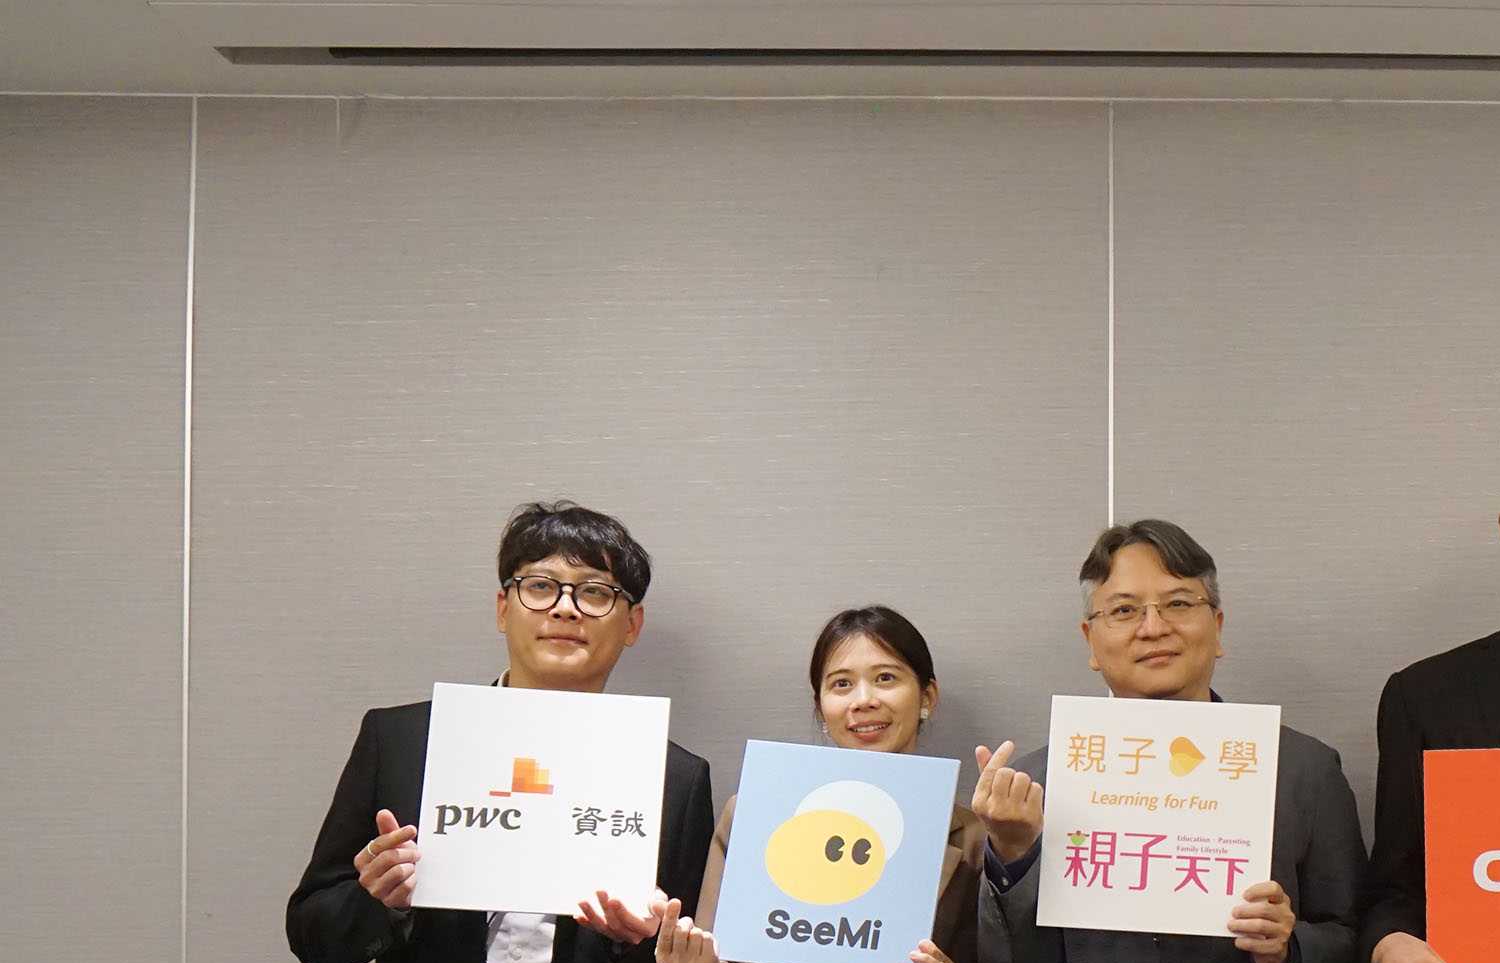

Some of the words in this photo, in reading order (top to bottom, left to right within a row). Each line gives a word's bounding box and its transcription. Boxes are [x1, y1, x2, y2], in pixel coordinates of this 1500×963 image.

[1066, 733, 1157, 776] 親子
[433, 803, 522, 835] pwc
[1090, 790, 1158, 811] Learning
[1163, 793, 1187, 809] for
[1188, 795, 1218, 811] Fun
[572, 806, 647, 838] 資誠
[1064, 830, 1249, 897] 親子天下
[765, 908, 883, 952] SeeMi
